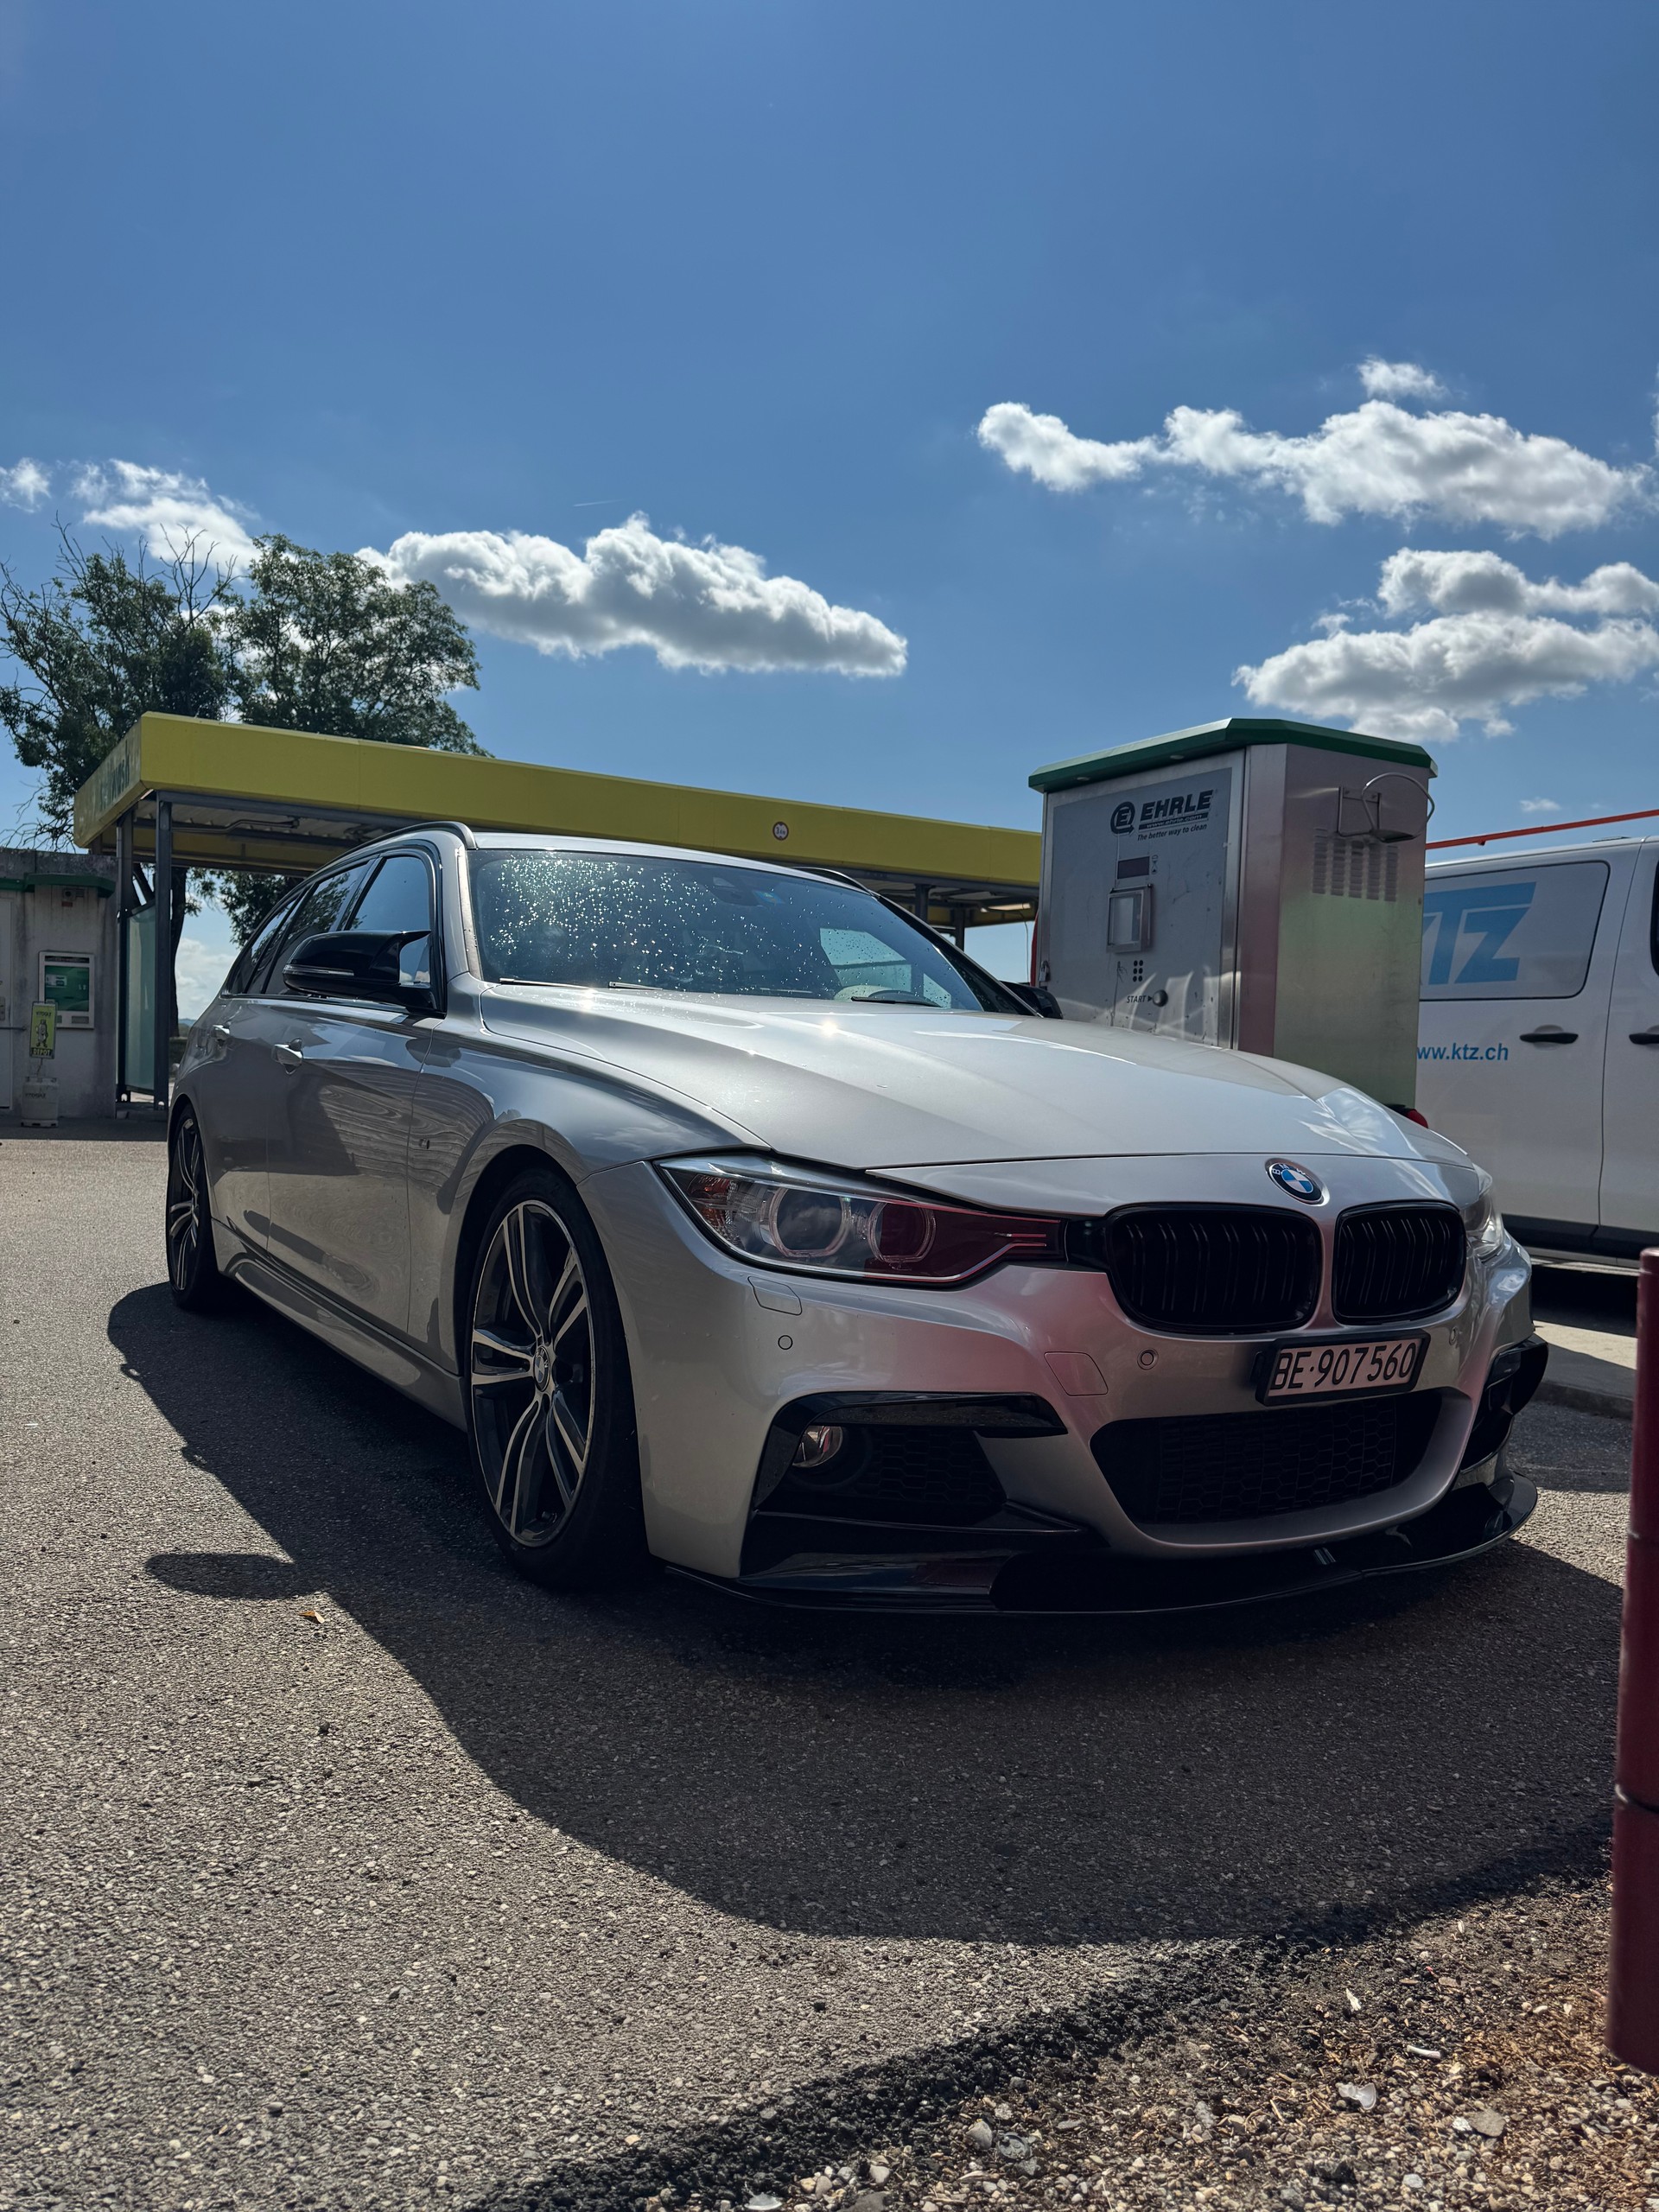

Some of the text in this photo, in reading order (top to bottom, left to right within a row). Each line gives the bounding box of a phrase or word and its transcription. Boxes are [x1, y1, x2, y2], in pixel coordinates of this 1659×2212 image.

[1141, 790, 1213, 821] EHRLE
[1148, 830, 1168, 839] better
[1169, 827, 1182, 836] way
[1191, 823, 1208, 832] clean
[1423, 881, 1536, 985] TZ
